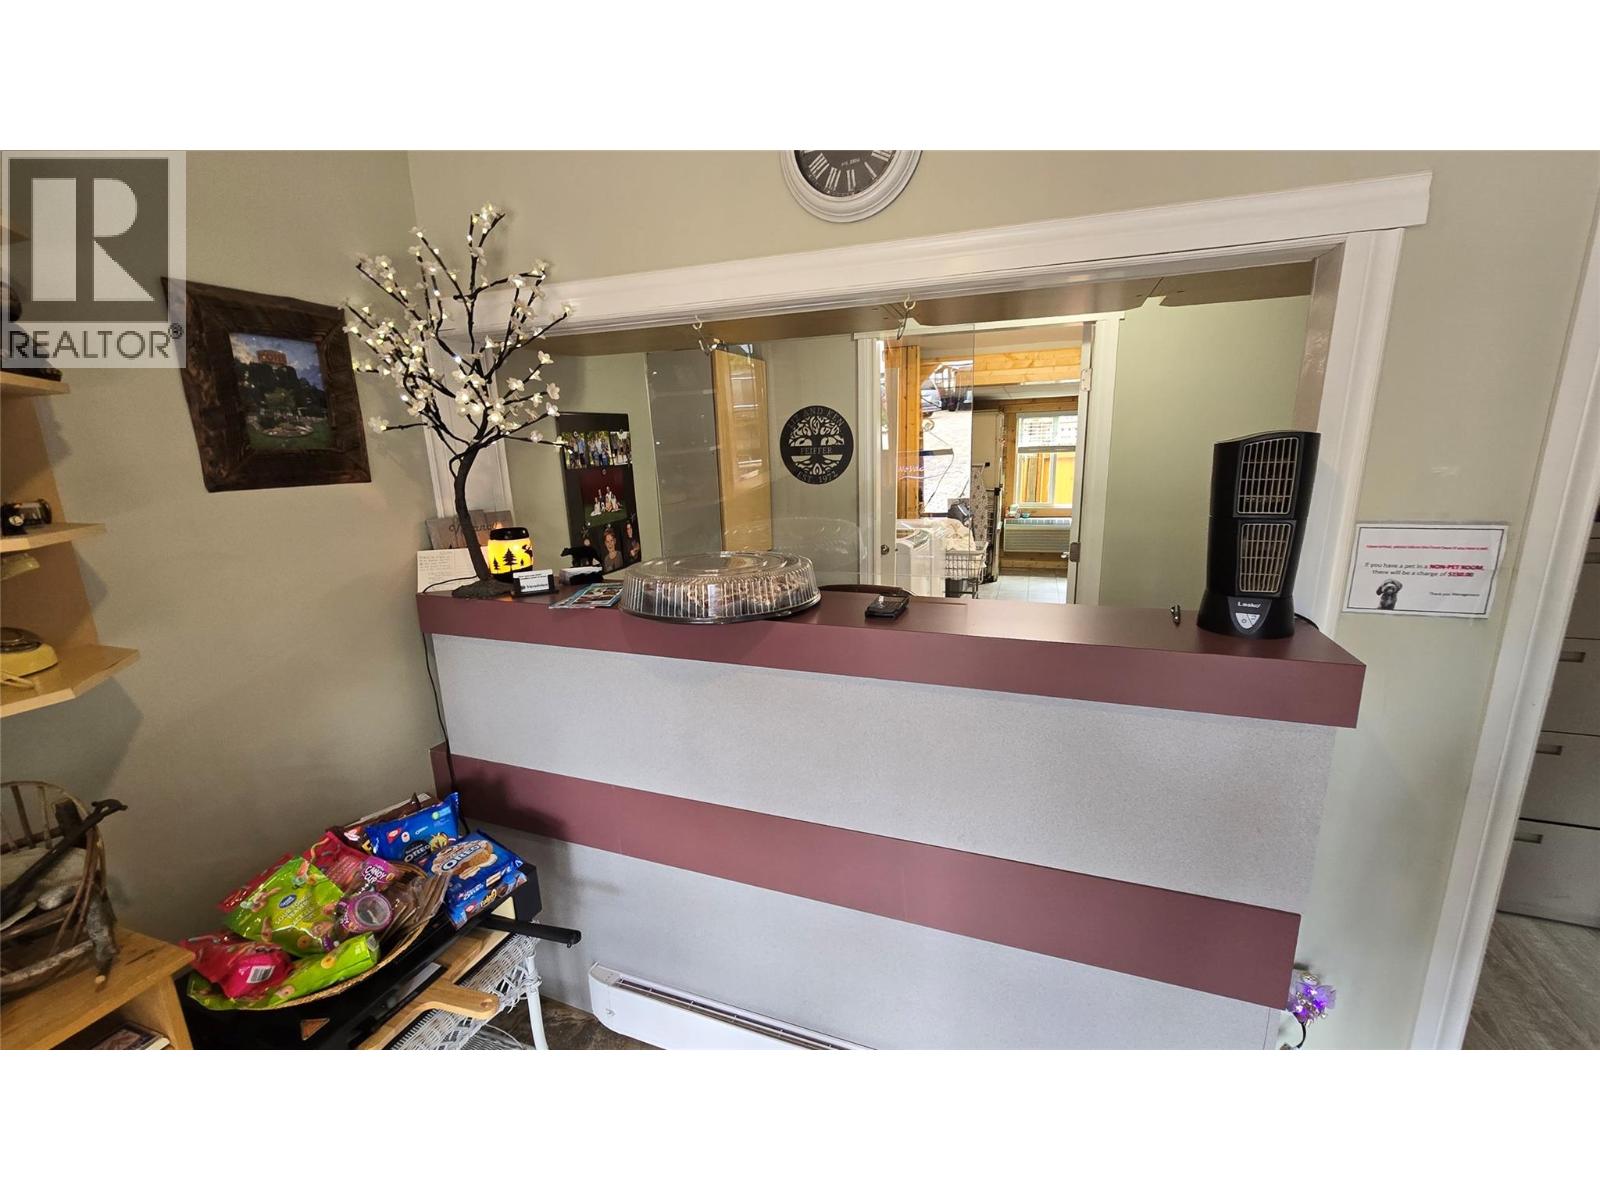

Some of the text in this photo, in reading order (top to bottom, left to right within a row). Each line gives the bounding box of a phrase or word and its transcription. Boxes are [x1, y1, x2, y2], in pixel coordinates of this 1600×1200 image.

[404, 844, 430, 863] OREO
[442, 844, 481, 871] OREO
[364, 865, 387, 880] CANDY
